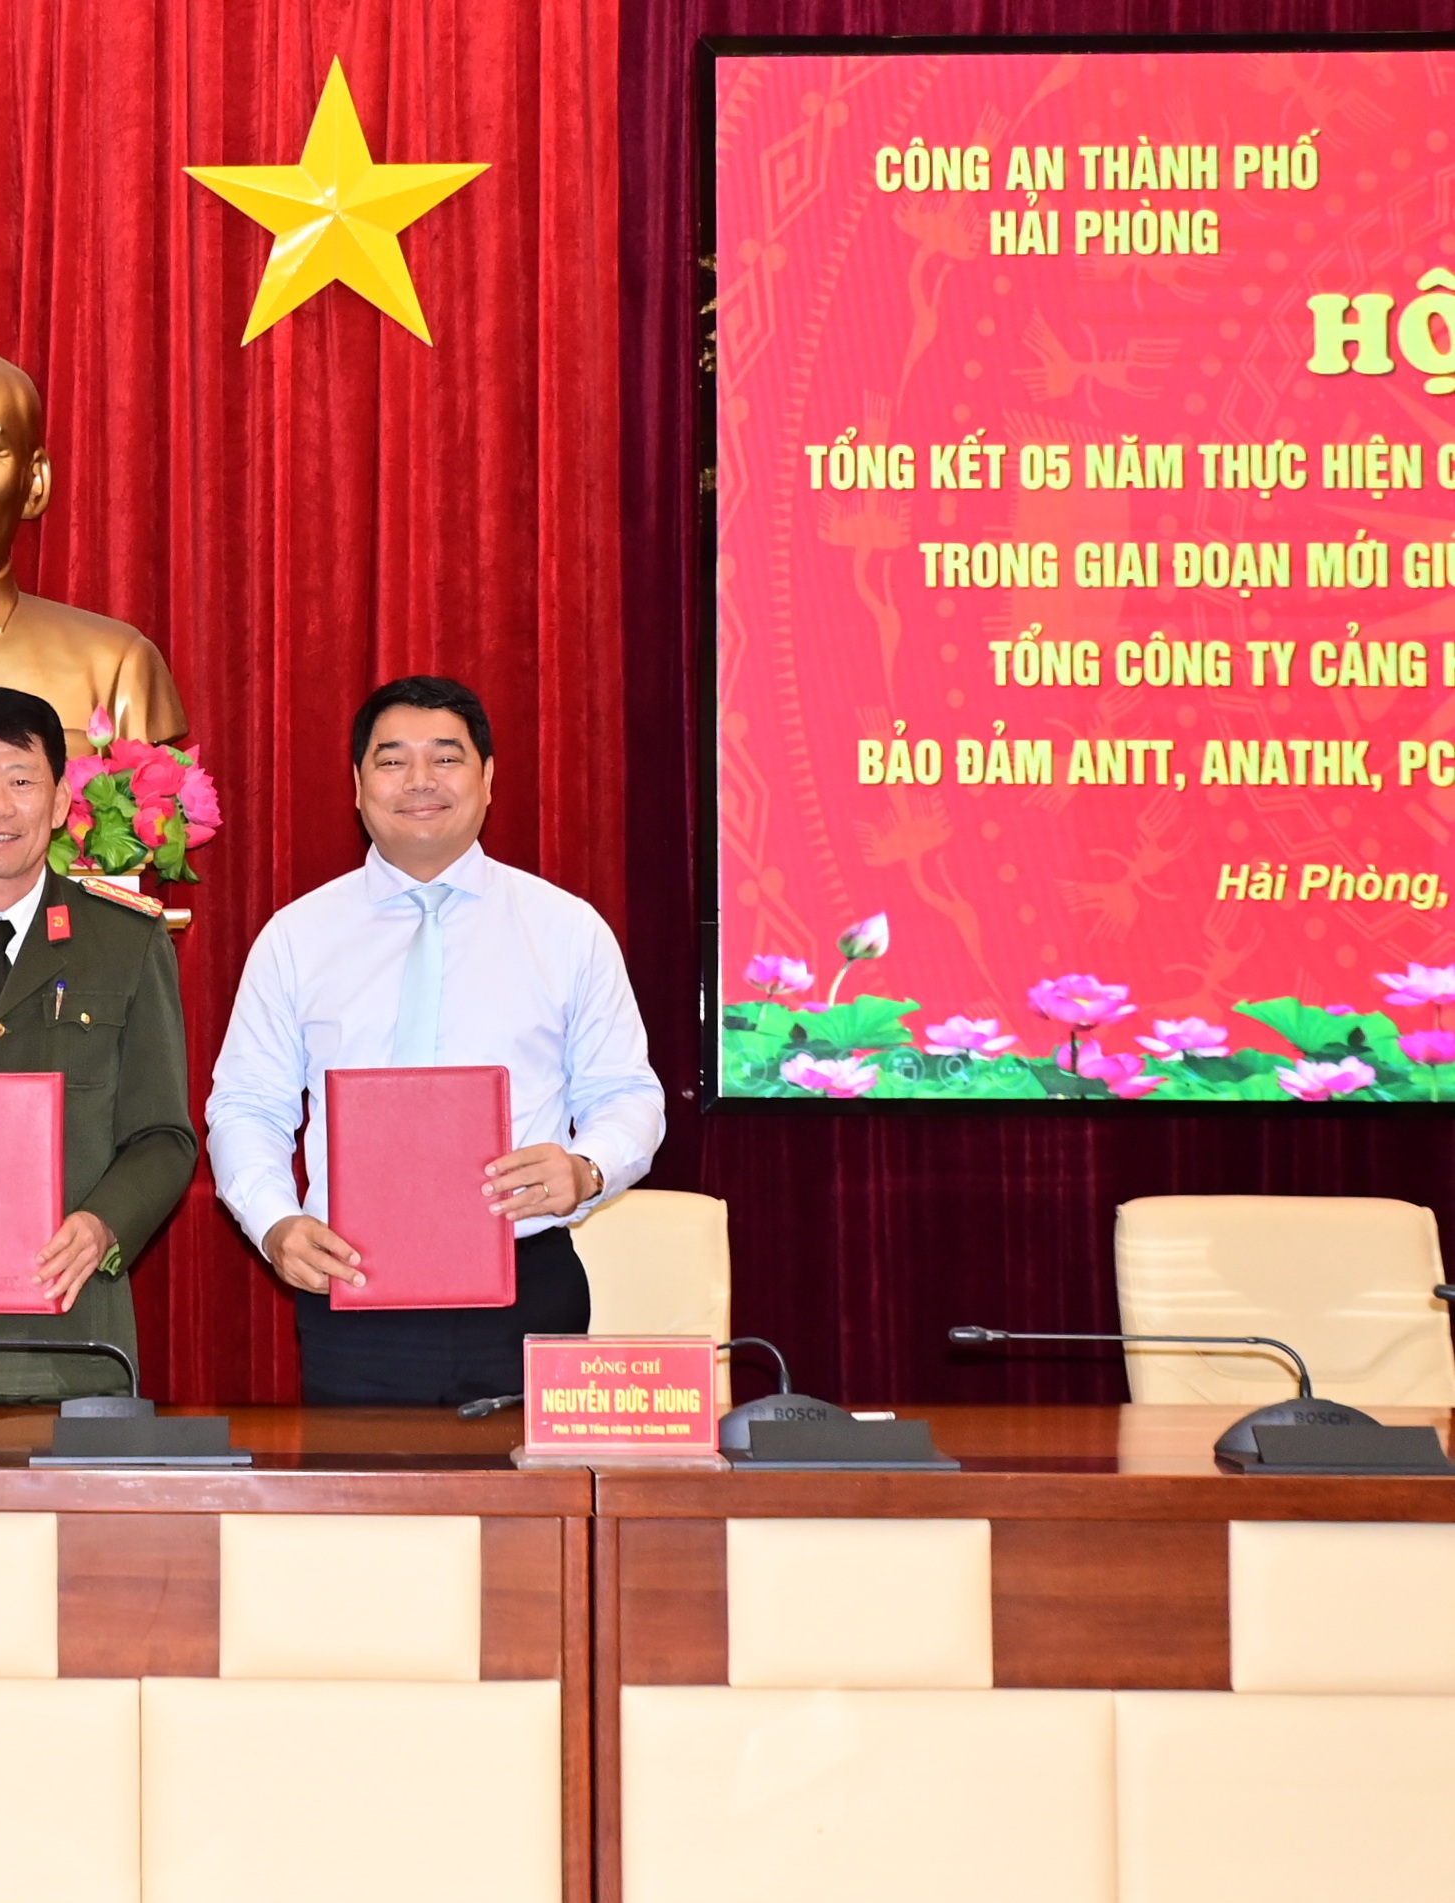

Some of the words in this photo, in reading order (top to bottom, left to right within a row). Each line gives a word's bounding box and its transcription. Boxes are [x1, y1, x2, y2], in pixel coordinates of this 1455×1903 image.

[875, 136, 990, 192] CÔNG
[1005, 146, 1064, 190] AN
[1079, 136, 1218, 190] THÀNH
[1233, 129, 1320, 189] PHỐ
[990, 191, 1059, 255] HẢI
[1075, 199, 1219, 255] PHÒNG
[804, 427, 915, 490] TỔNG
[930, 428, 1006, 489] KẾT
[1019, 444, 1071, 490] 05
[1084, 434, 1184, 489] NĂM
[1197, 439, 1307, 499] THỰC
[1322, 434, 1423, 500] HIỆN
[918, 541, 1059, 588] TRONG
[1074, 541, 1158, 588] GIAI
[1172, 541, 1290, 598] ĐOẠN
[1307, 529, 1389, 588] MỚI
[988, 623, 1100, 687] TỔNG
[1115, 631, 1231, 687] CÔNG
[1246, 641, 1296, 686] TY
[1310, 621, 1427, 687] CẢNG
[857, 720, 942, 785] BẢO
[955, 720, 1053, 784] ĐẢM
[1066, 739, 1186, 791] ANTT,
[1200, 739, 1383, 792] ANATHK,
[1216, 862, 1288, 901] Hải
[1298, 864, 1449, 910] Phòng,
[541, 1380, 610, 1413] NGUYỄN
[614, 1383, 649, 1413] ĐỨC
[653, 1383, 701, 1413] HÙNG
[580, 1356, 627, 1375] ĐỒNG
[631, 1358, 661, 1375] CHÍ
[774, 1407, 827, 1421] BOSCH
[1294, 1411, 1350, 1425] BOSCH
